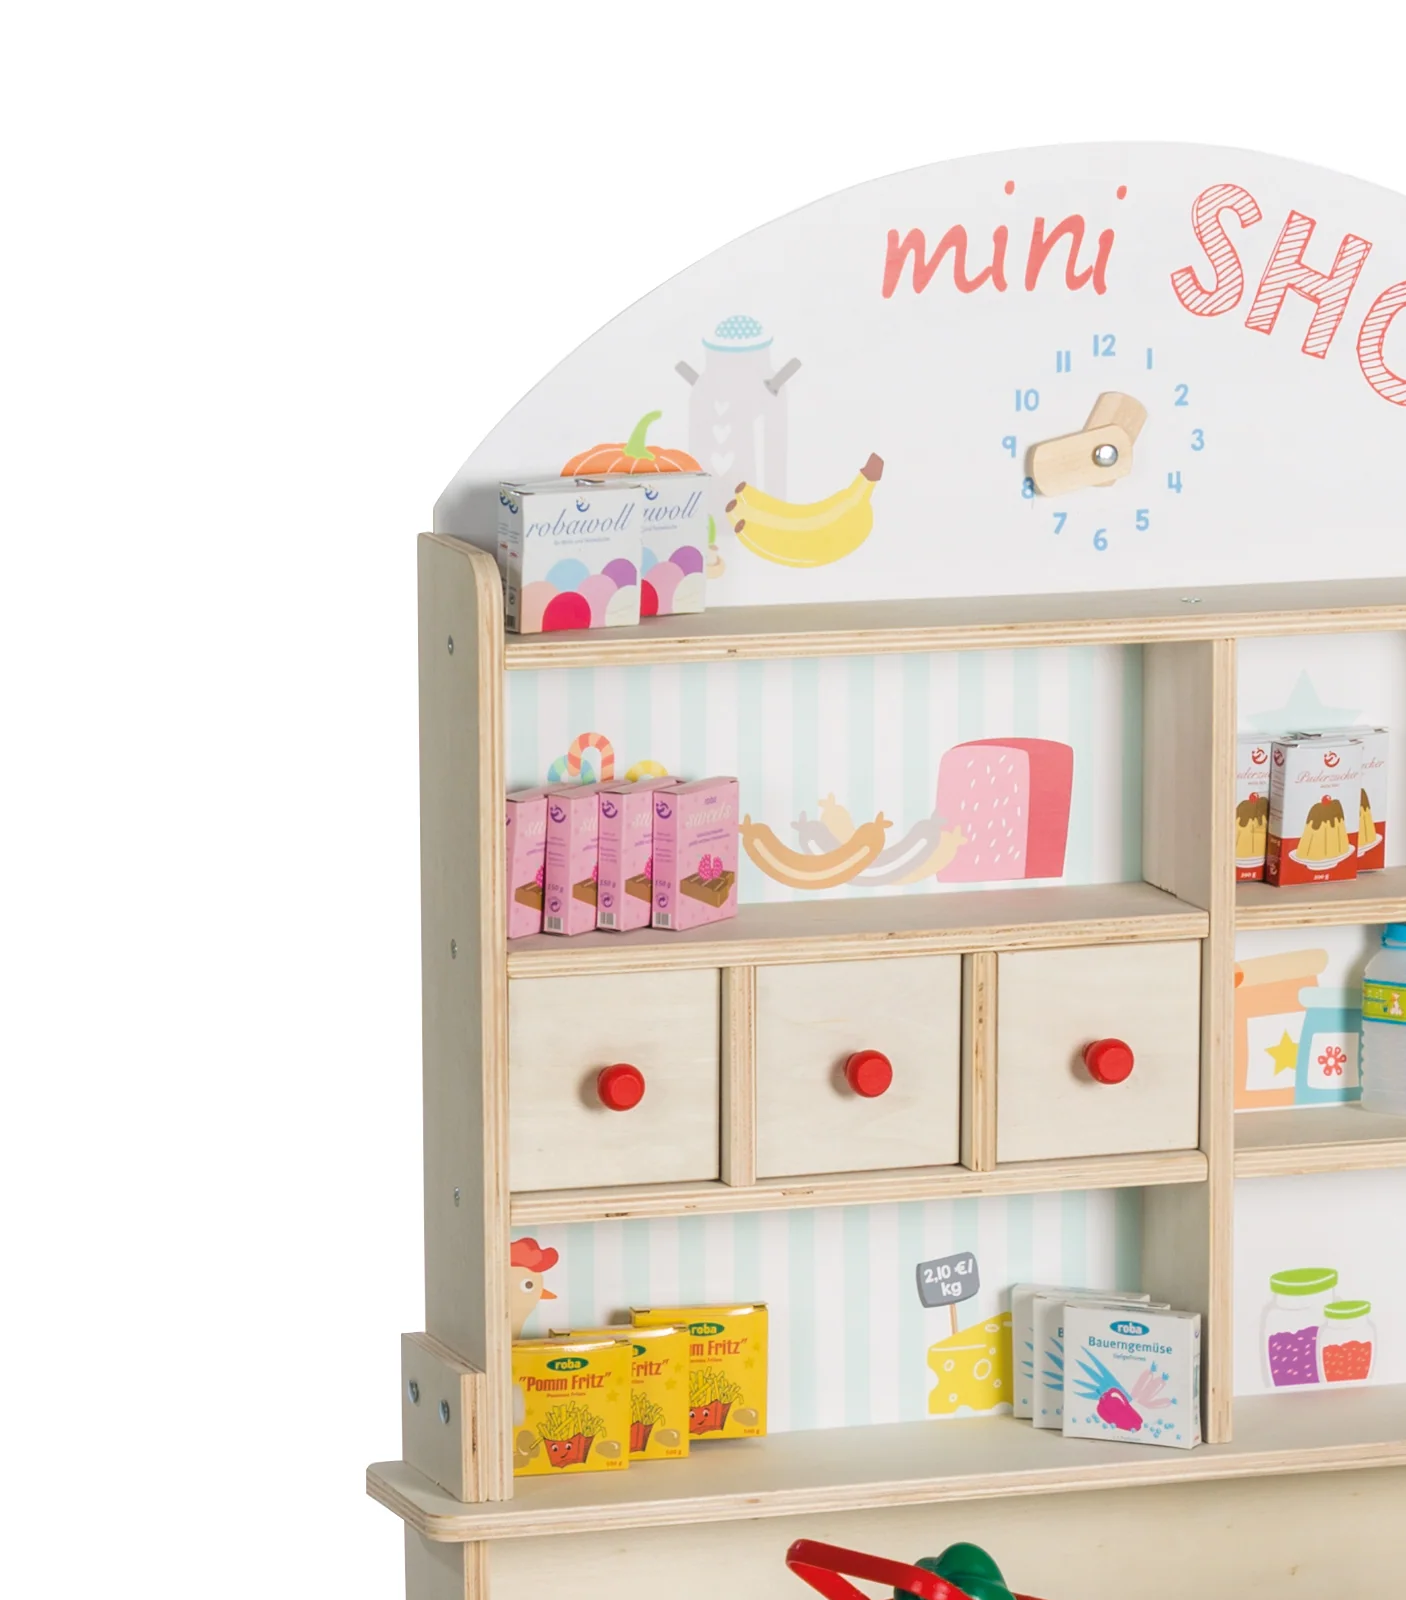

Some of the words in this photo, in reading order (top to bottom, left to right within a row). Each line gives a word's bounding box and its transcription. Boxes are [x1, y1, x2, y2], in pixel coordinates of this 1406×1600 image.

[882, 180, 1126, 298] mini
[1093, 334, 1116, 357] 12
[1056, 351, 1071, 373] 11
[1146, 348, 1152, 370] 1
[1015, 389, 1040, 412] 10
[1174, 384, 1189, 406] 2
[1002, 436, 1017, 458] 9
[1191, 428, 1204, 451] 3
[1022, 476, 1035, 499] 8
[1168, 471, 1182, 493] 4
[526, 502, 636, 538] robawoll
[1052, 512, 1068, 535] 7
[1136, 509, 1150, 532] 5
[1093, 528, 1108, 552] 6
[1295, 769, 1359, 784] Puderzucker
[924, 1265, 951, 1283] 2,10
[954, 1259, 973, 1275] €/
[941, 1281, 962, 1296] kg
[692, 1324, 717, 1334] roba
[1118, 1322, 1143, 1335] roba
[1088, 1336, 1173, 1354] Bauerngemüse
[555, 1358, 581, 1370] roba
